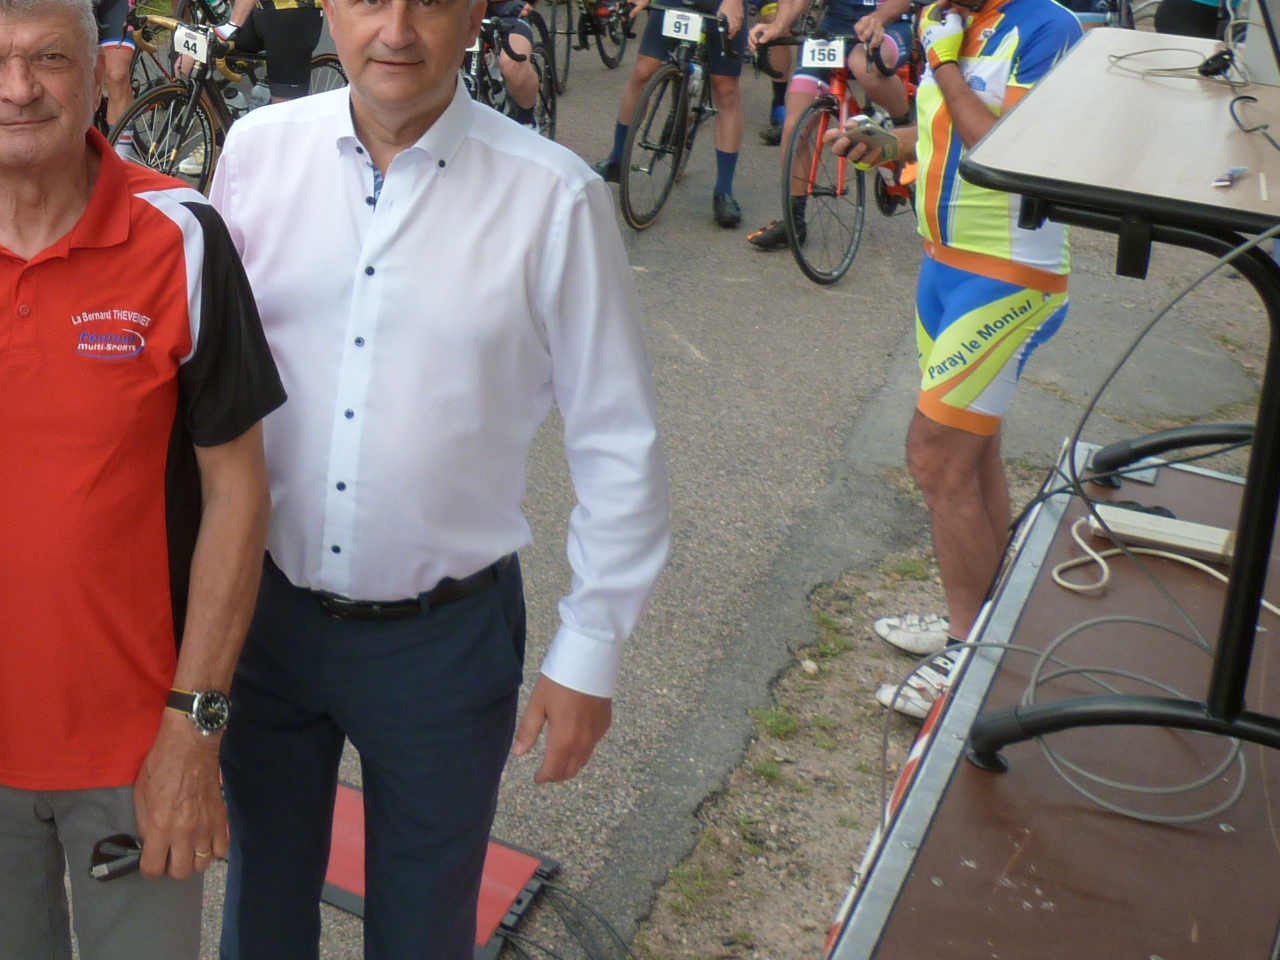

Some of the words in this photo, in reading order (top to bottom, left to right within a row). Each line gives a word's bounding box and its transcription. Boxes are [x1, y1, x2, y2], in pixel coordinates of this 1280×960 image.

[673, 21, 689, 35] 91
[183, 39, 198, 55] 44
[809, 48, 837, 62] 156
[71, 314, 82, 326] La
[82, 309, 112, 322] Bernard
[112, 309, 151, 327] THEVENET
[927, 351, 969, 380] Paray
[961, 340, 982, 354] le
[976, 299, 1034, 341] Monial
